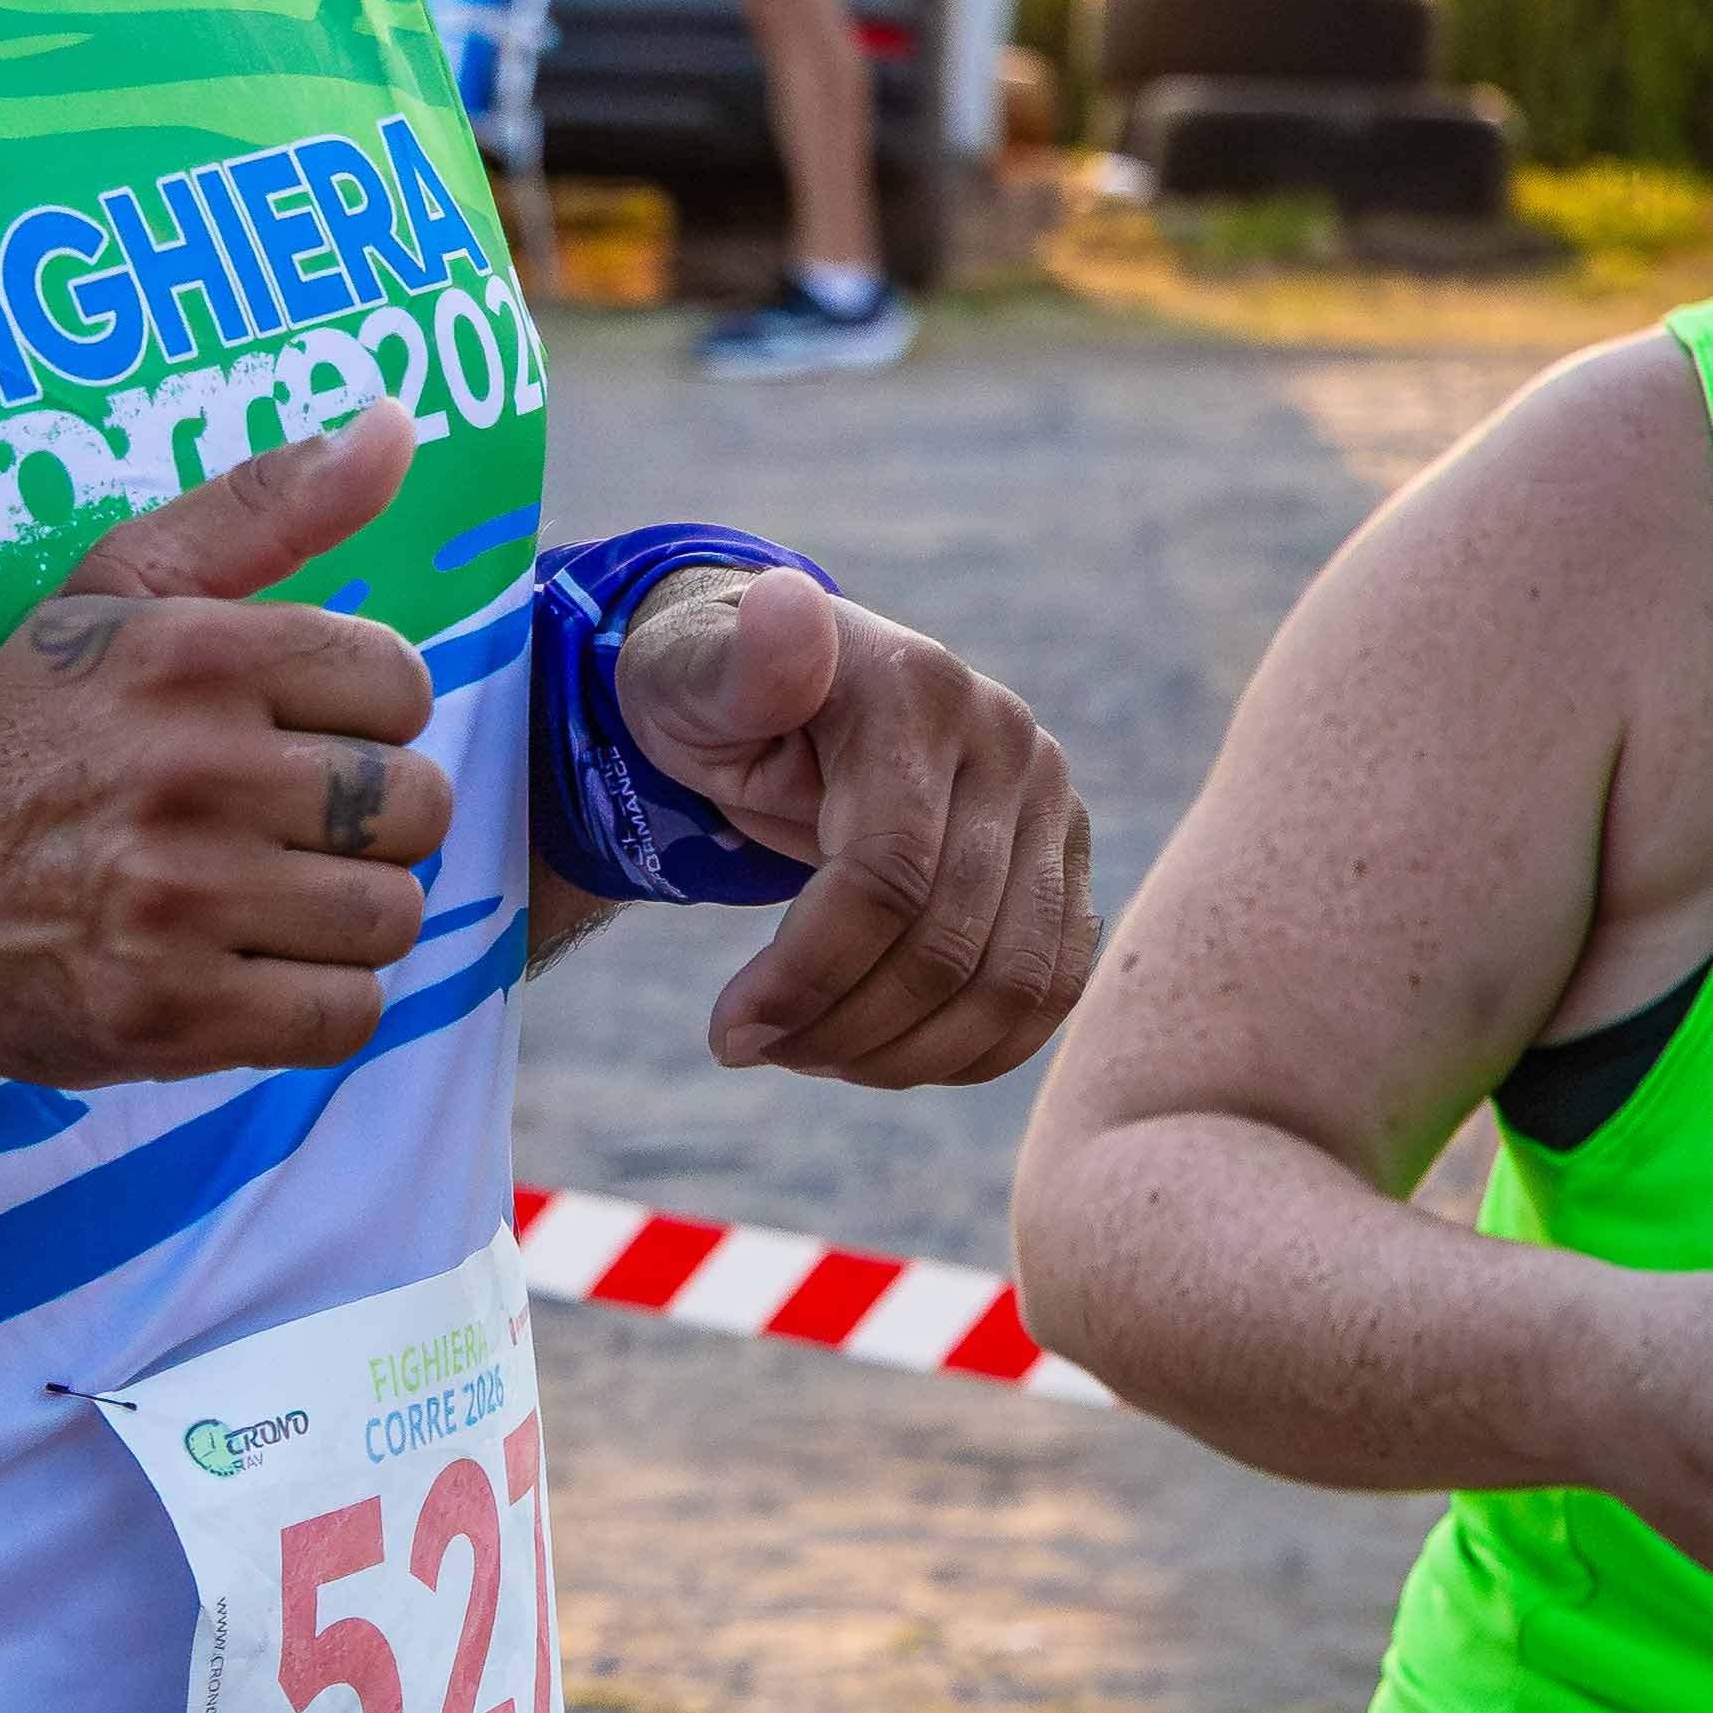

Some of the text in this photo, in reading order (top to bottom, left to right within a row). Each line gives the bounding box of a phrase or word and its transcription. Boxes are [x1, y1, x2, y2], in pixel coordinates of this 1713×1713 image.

[357, 264, 548, 448] 202
[366, 1363, 504, 1464] CORRE 2026
